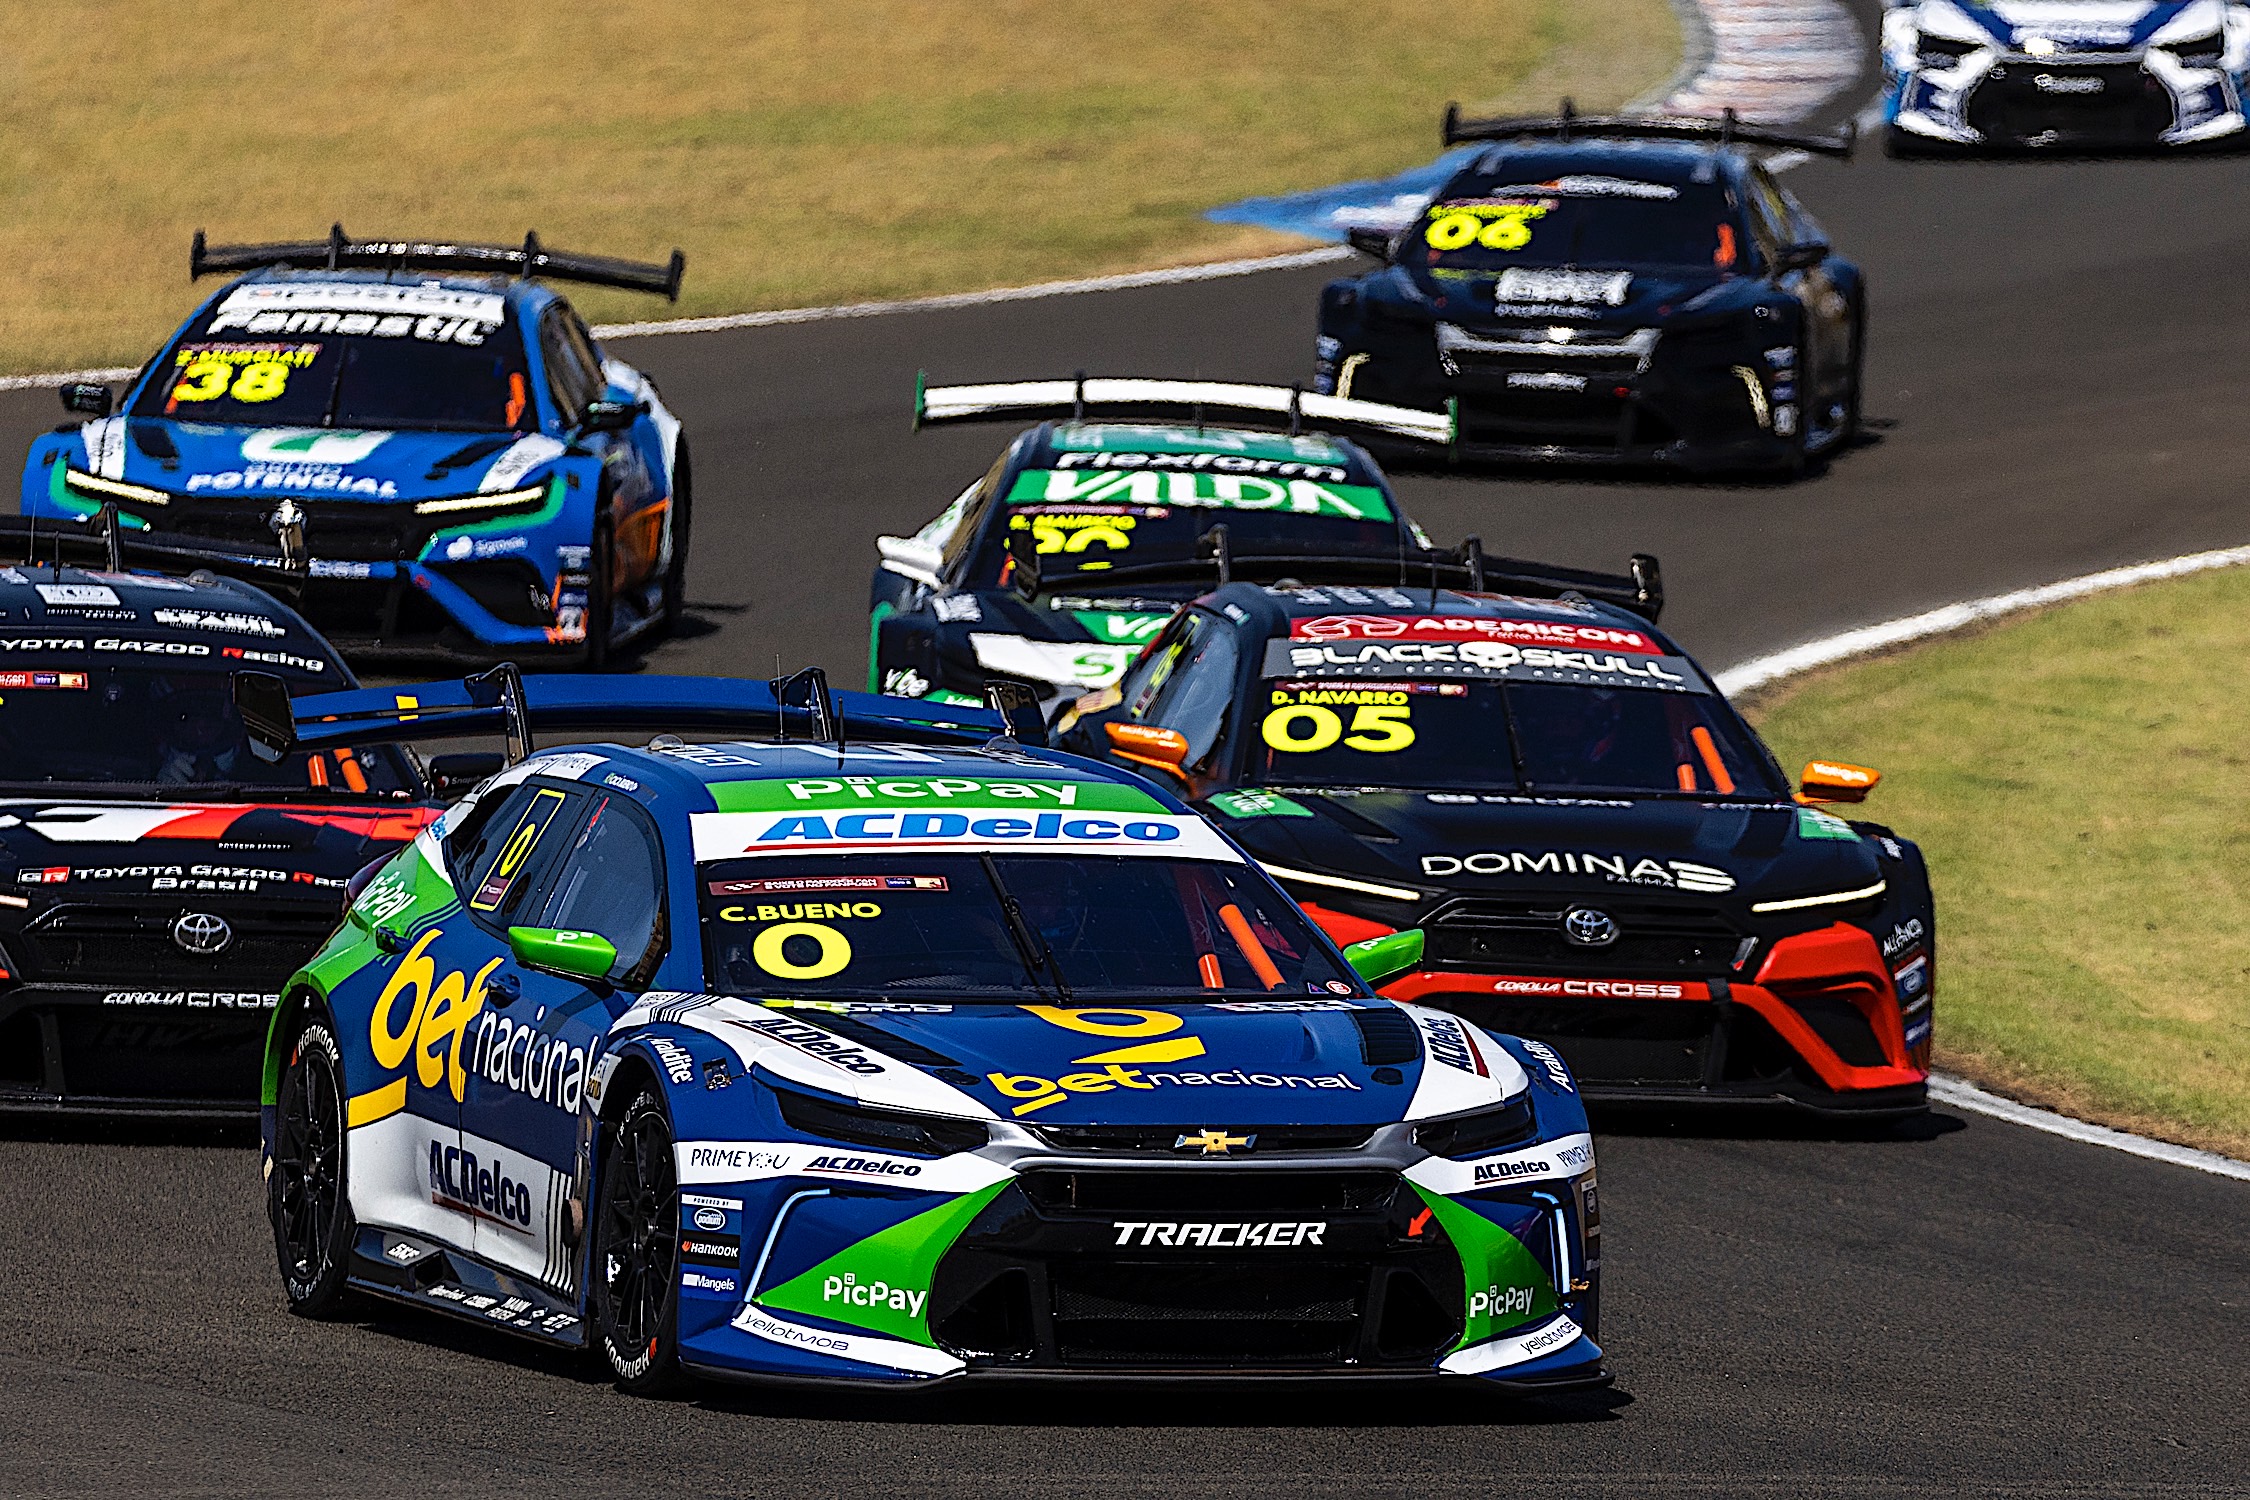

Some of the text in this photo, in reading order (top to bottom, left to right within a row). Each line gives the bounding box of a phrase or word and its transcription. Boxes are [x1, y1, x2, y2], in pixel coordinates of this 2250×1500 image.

[173, 361, 290, 403] 38
[186, 471, 399, 499] POTENCIAL
[1044, 470, 1364, 517] VALDA
[1413, 617, 1643, 647] ADEMICON
[1290, 644, 1457, 668] BLACK
[1520, 647, 1684, 683] SKULL
[1299, 691, 1409, 705] NAVARRO
[1262, 704, 1416, 753] 05
[786, 776, 1078, 805] PicPay
[756, 813, 1181, 842] ACDelco
[75, 866, 183, 880] TOYOTA
[152, 877, 259, 892] Brasil
[719, 902, 882, 922] C.BUENO
[752, 922, 852, 980] 0
[1563, 980, 1683, 999] CROSS
[740, 1018, 886, 1076] ACDelco
[806, 1156, 922, 1177] ACDelco
[1474, 1160, 1551, 1181] ACDelco
[429, 1139, 532, 1227] ACDelco
[1113, 1221, 1327, 1247] TRACKER
[695, 1275, 735, 1291] Mangels
[823, 1272, 927, 1318] PicPay
[1469, 1284, 1535, 1318] PicPay
